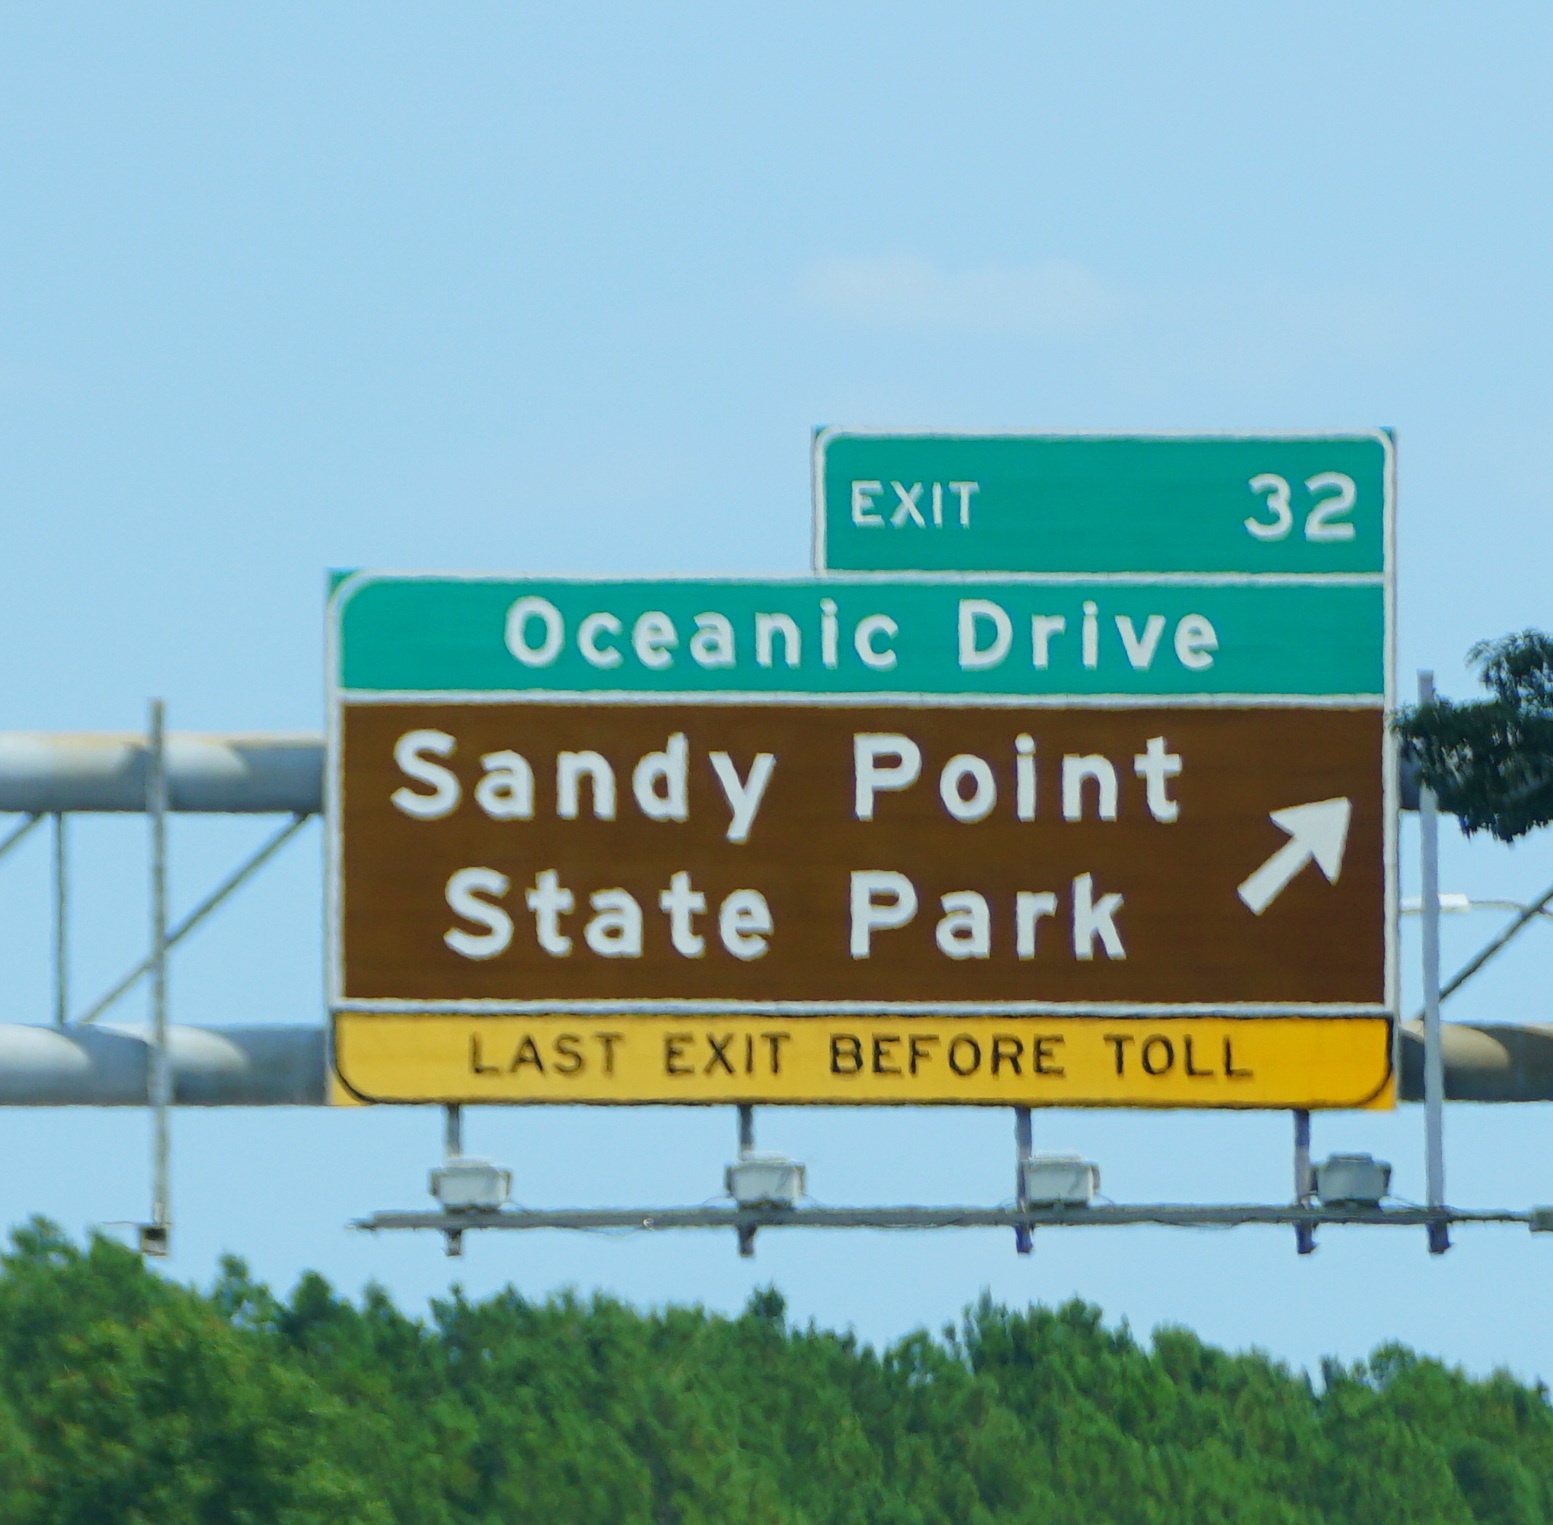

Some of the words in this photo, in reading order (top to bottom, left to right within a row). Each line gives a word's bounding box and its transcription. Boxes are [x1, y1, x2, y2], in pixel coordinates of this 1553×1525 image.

[850, 479, 980, 529] EXIT
[1244, 471, 1357, 541] 32
[504, 594, 900, 672] Oceanic
[958, 598, 1219, 671] Drive
[390, 728, 777, 844] Sandy
[853, 731, 1183, 823] Point
[443, 865, 775, 961] State
[849, 868, 1127, 960] Park
[468, 1032, 623, 1075] LAST
[662, 1031, 791, 1076] EXIT
[828, 1033, 1065, 1077] BEFORE
[1103, 1033, 1253, 1078] TOLL
